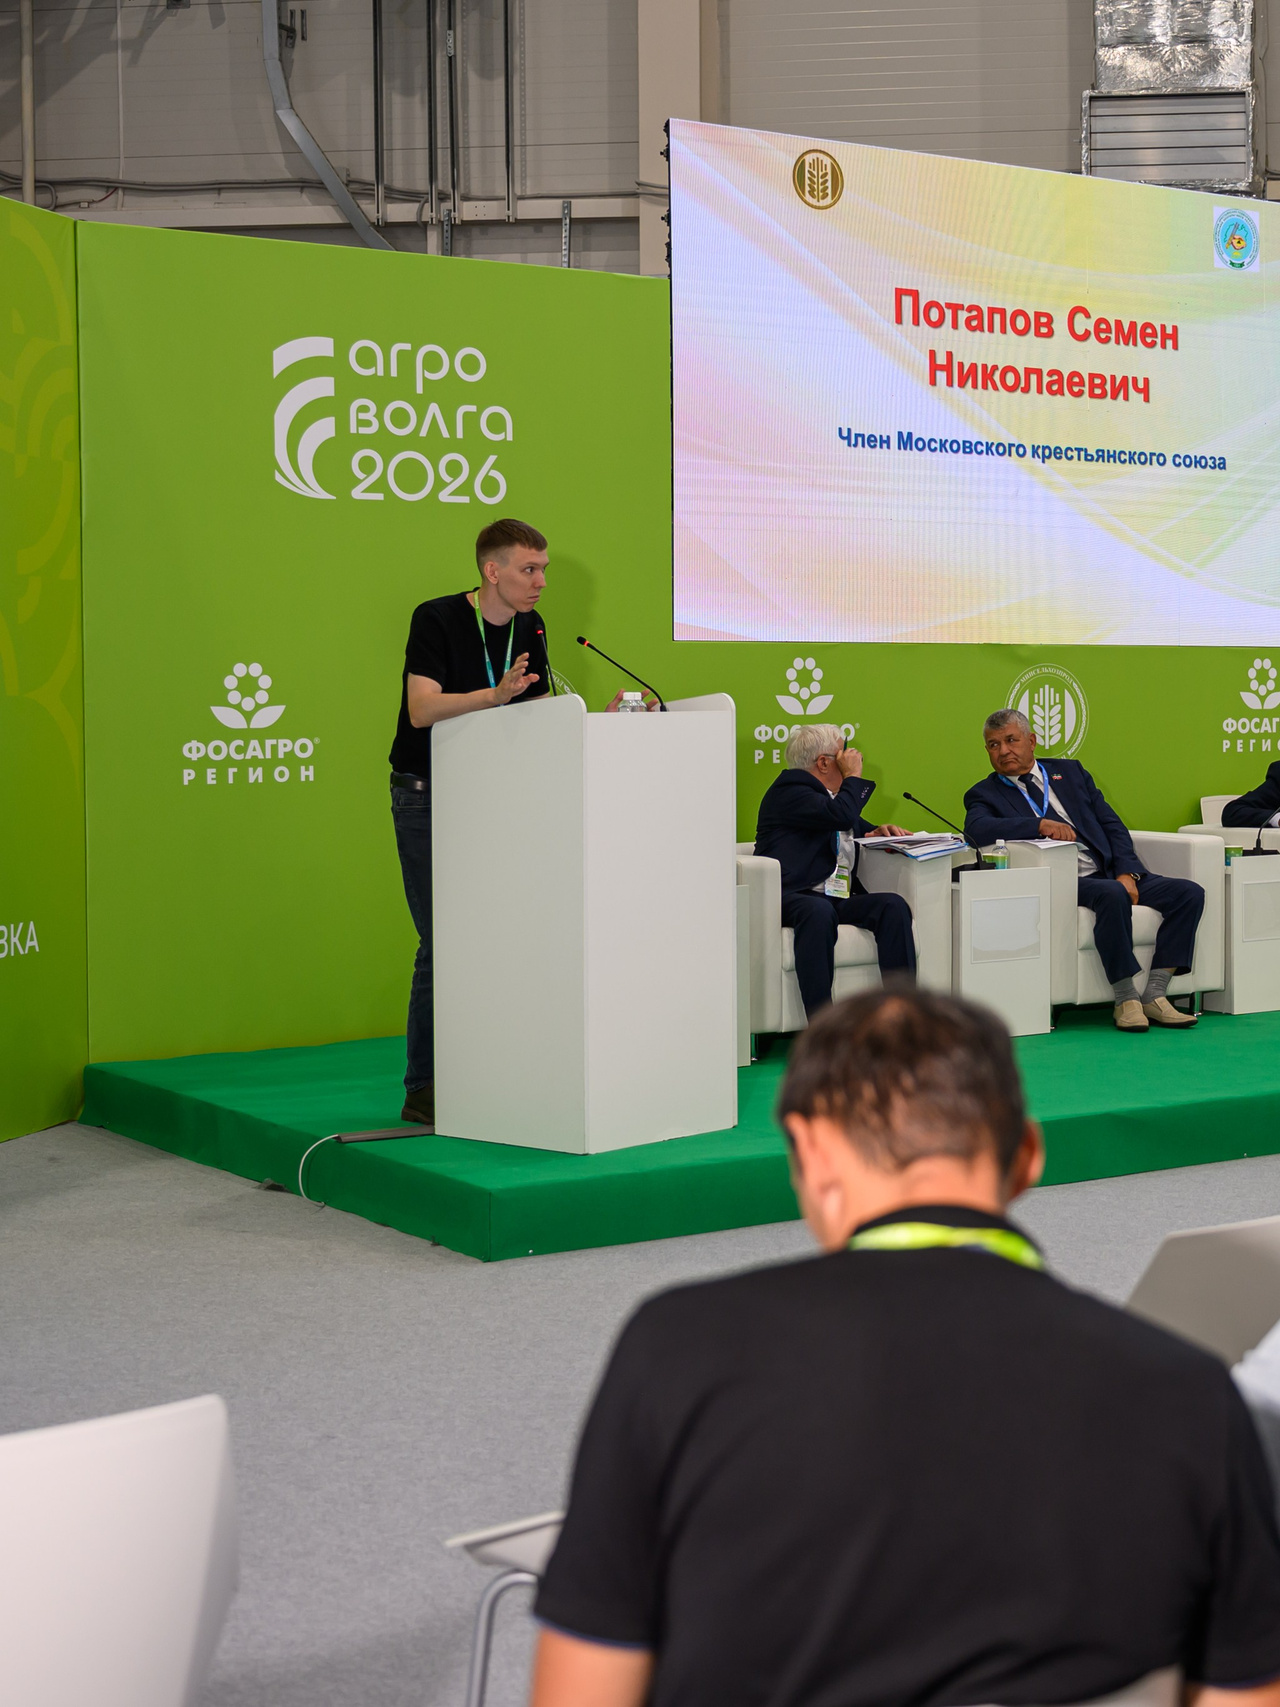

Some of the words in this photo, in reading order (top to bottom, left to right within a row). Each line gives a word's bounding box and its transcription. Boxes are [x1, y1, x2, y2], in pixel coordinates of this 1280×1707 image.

[894, 287, 1054, 339] Потапов
[1067, 305, 1179, 351] Семен
[928, 349, 1151, 403] Николаевич
[838, 426, 891, 451] Член
[897, 430, 1027, 459] Московского
[1031, 444, 1167, 468] крестьянского
[1171, 453, 1227, 471] союза
[350, 448, 508, 505] 2026
[182, 765, 315, 786] РЕГИОН
